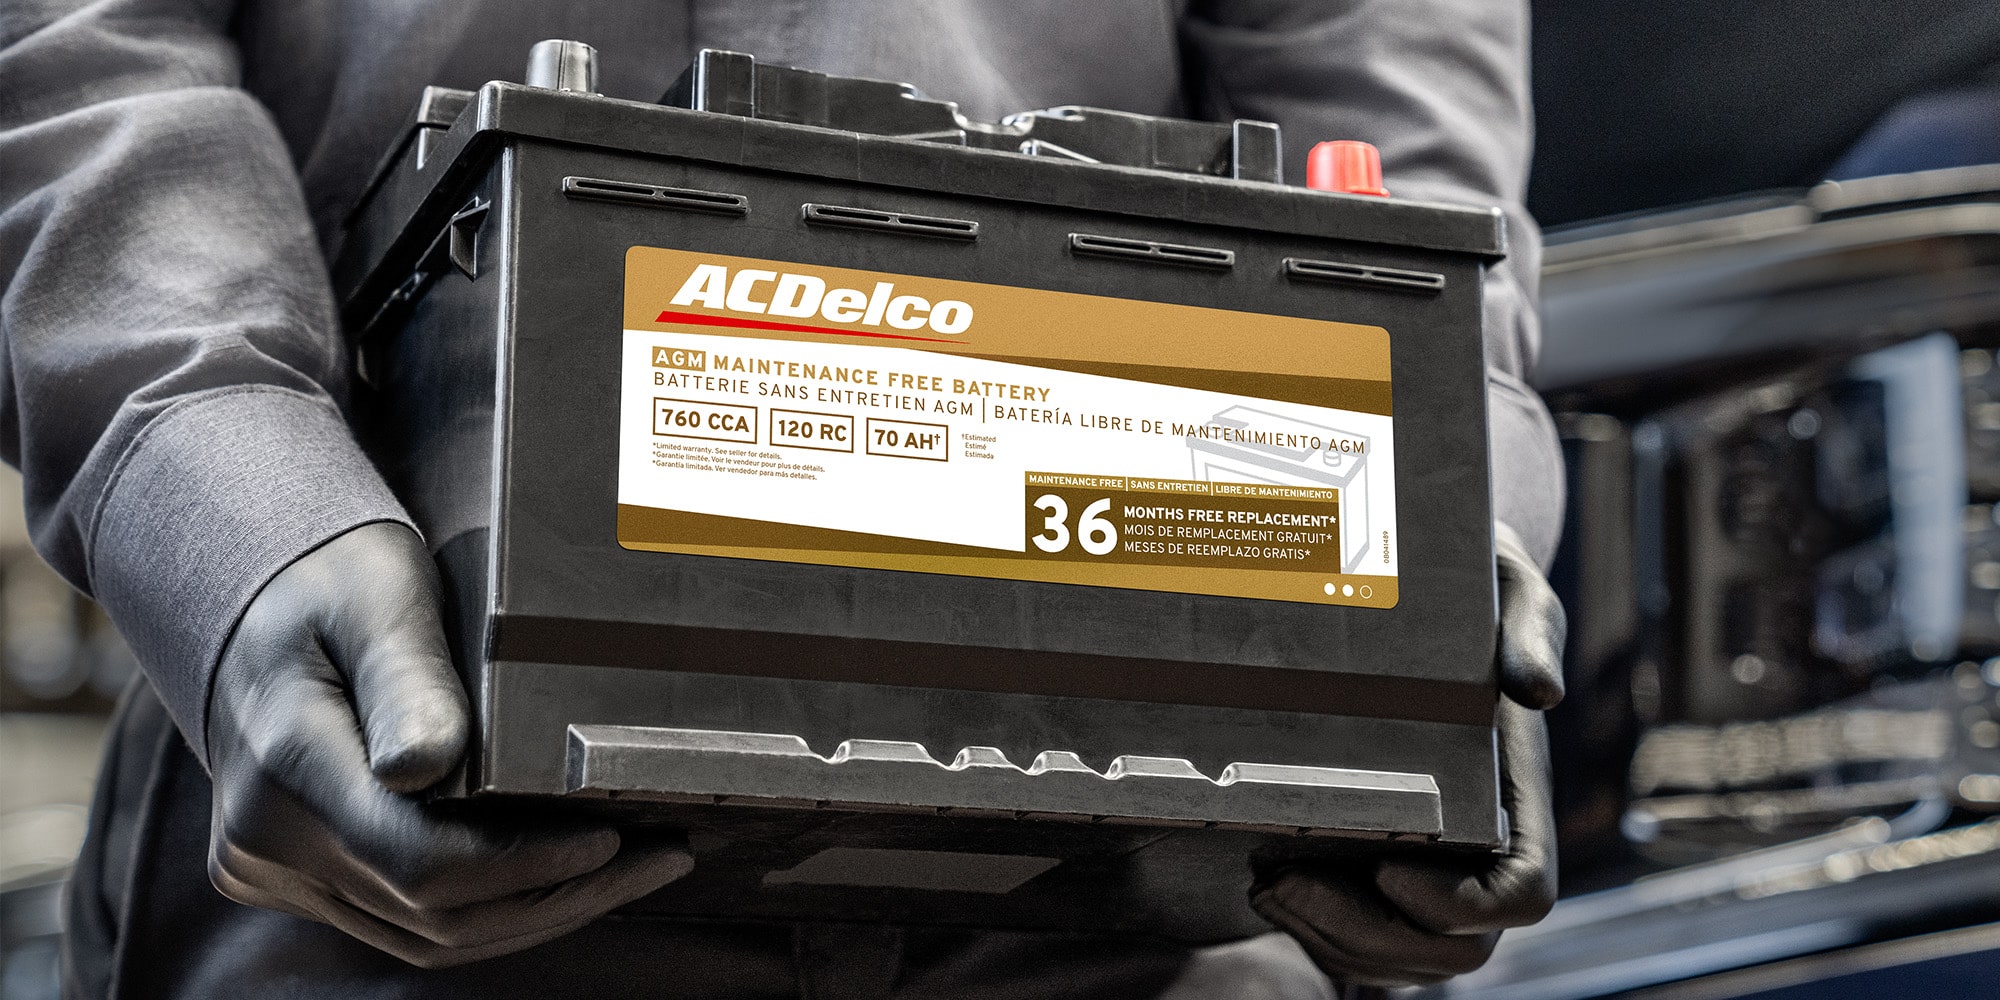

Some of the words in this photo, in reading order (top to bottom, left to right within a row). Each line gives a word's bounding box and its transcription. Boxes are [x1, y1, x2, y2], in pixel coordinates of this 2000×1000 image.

[669, 263, 974, 334] ACDelco
[655, 350, 703, 368] AGM
[714, 355, 878, 386] MAINTENANCE
[889, 373, 943, 392] FREE
[953, 379, 1051, 402] BATTERY
[654, 372, 749, 394] BATTERIE
[758, 382, 809, 400] SANS
[818, 388, 925, 411] ENTRETIEN
[934, 399, 973, 416] AGM
[995, 406, 1073, 426] BATERÍA
[1081, 414, 1133, 432] LIBRE
[1142, 420, 1163, 435] DE
[1172, 423, 1321, 450] MANTENIMIENTO
[1328, 438, 1365, 455] AGM
[661, 409, 701, 428] 760
[708, 413, 750, 433] CCA
[778, 420, 813, 438] 120
[820, 424, 847, 442] RC
[874, 430, 898, 447] 70
[1029, 475, 1097, 486] MAINTENANCE
[1100, 479, 1123, 489] FREE
[1130, 481, 1154, 490] SANS
[1157, 483, 1208, 493] ENTRETIEN
[1215, 485, 1242, 495] LIBRE
[1244, 487, 1256, 496] DE
[1258, 488, 1333, 499] MANTENIMIENTO
[1032, 494, 1118, 555] 36
[1124, 506, 1184, 520] MONTHS
[1188, 509, 1224, 523] FREE
[1124, 525, 1154, 537] MOIS
[1158, 526, 1173, 538] DE
[1177, 527, 1273, 542] REMPLACEMENT
[1124, 541, 1164, 553] MESES
[1168, 543, 1183, 554] DE
[1187, 544, 1260, 558] REEMPLAZO
